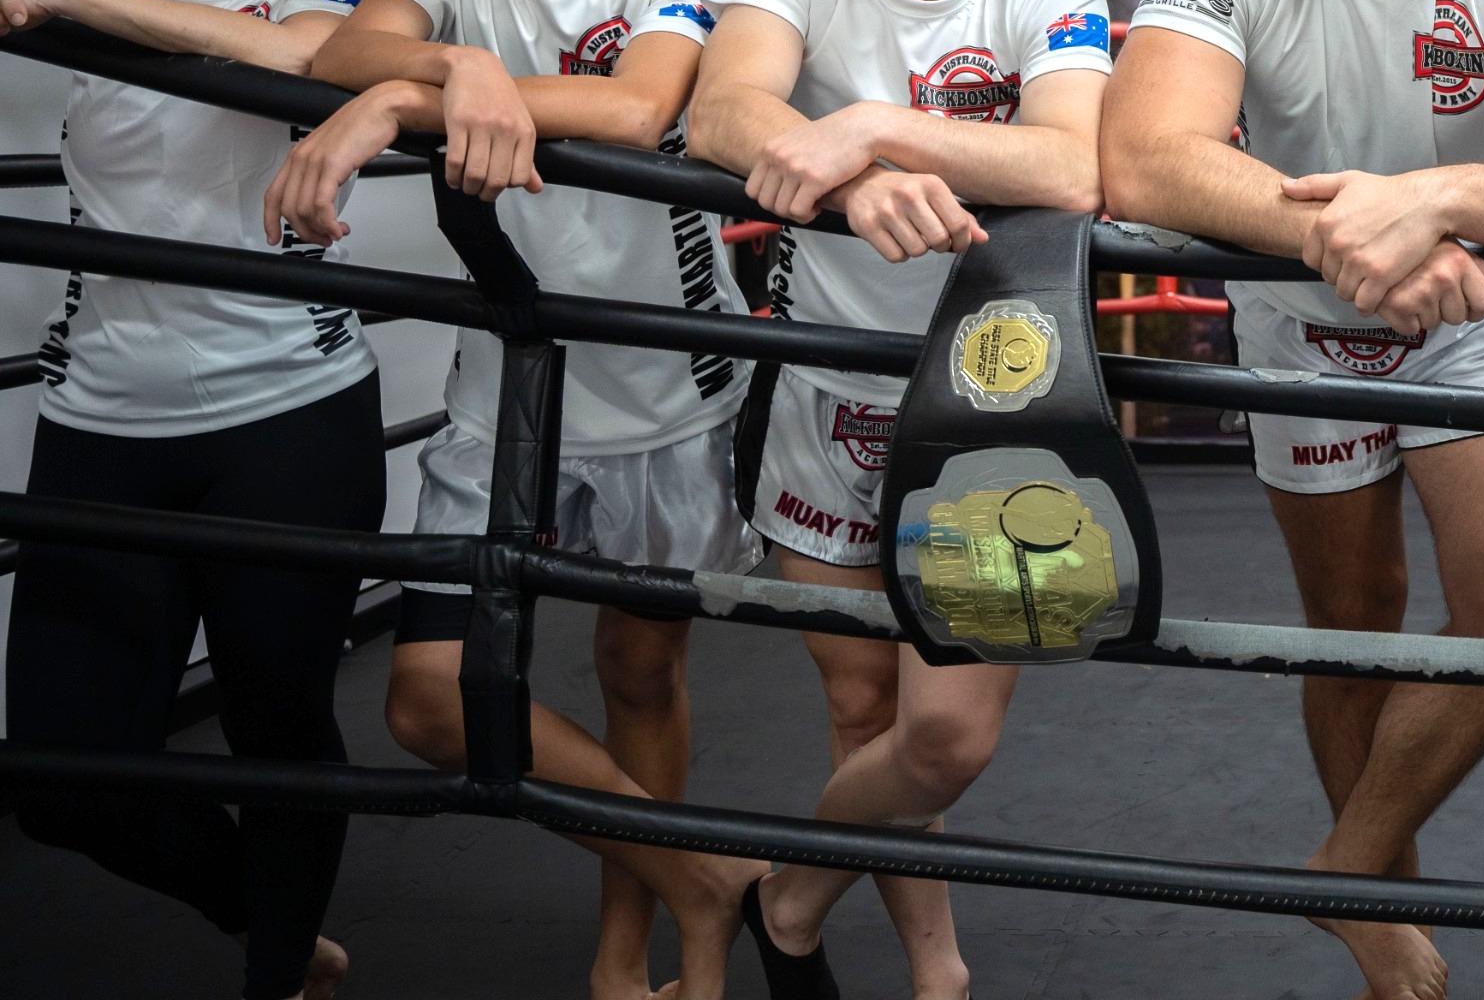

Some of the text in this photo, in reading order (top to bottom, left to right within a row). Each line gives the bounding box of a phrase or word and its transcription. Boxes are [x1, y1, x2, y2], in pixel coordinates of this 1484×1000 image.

[917, 81, 1020, 109] KICKBOXING
[1334, 349, 1394, 371] ACADEMY
[1291, 439, 1358, 466] MUAY
[773, 489, 846, 538] MUAY
